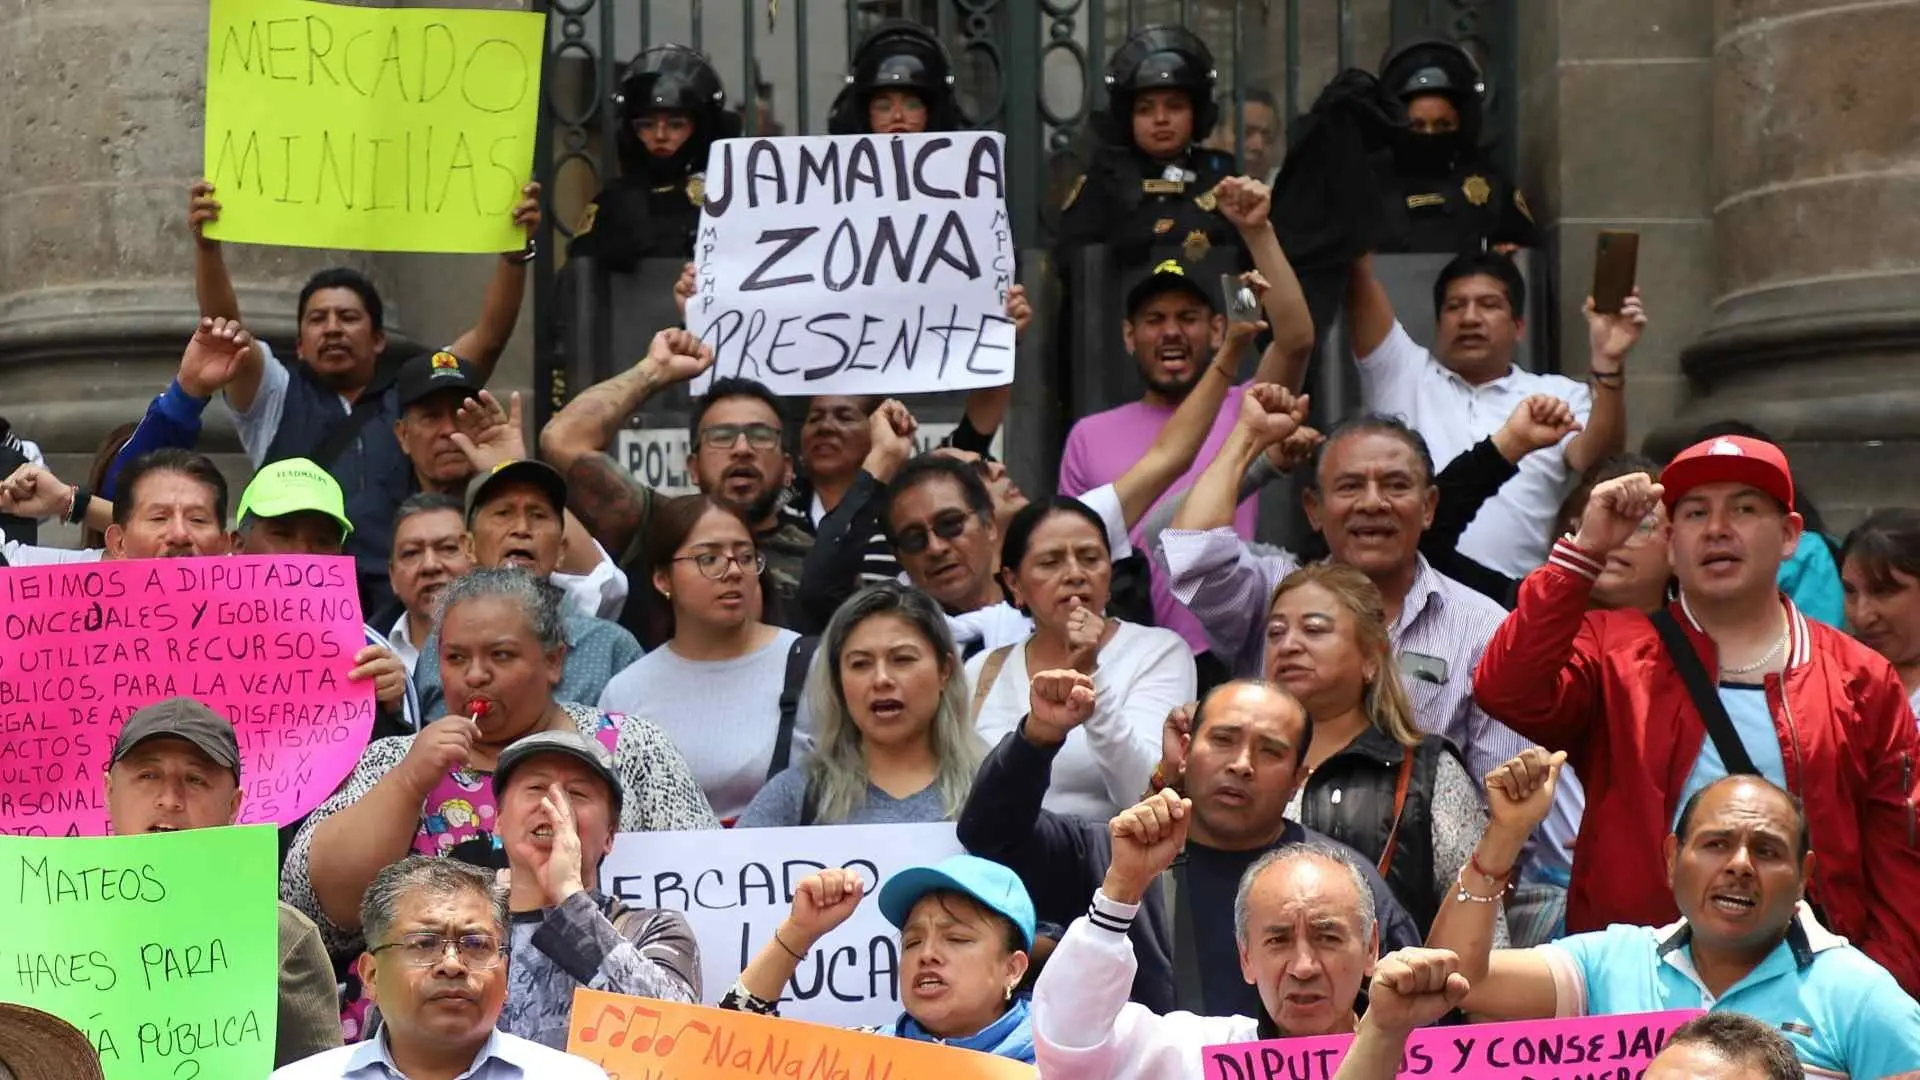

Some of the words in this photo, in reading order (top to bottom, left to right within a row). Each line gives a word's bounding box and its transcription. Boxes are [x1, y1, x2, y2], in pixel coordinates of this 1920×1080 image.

[218, 14, 529, 114] MERCADO
[703, 136, 1005, 218] JAMAICA
[739, 210, 982, 292] ZONA
[144, 568, 166, 595] A
[176, 563, 346, 593] DIPUTADOS
[191, 600, 209, 630] Y
[218, 597, 355, 626] GOBIERNO
[19, 637, 151, 673] UTILIZAR
[166, 630, 341, 664] RECURSOS
[114, 673, 177, 697] PARA
[192, 673, 228, 696] LA
[239, 667, 338, 696] VENTA
[68, 706, 99, 726] DE
[225, 699, 372, 728] DISFRAZADA
[0, 734, 92, 760] ACTOS
[74, 761, 90, 781] A
[295, 752, 312, 773] Y
[20, 855, 166, 904] MATEOS
[17, 951, 117, 994] HACES
[140, 938, 228, 991] PARA
[138, 1008, 262, 1063] PÚBLICA
[1452, 1037, 1476, 1075] Y
